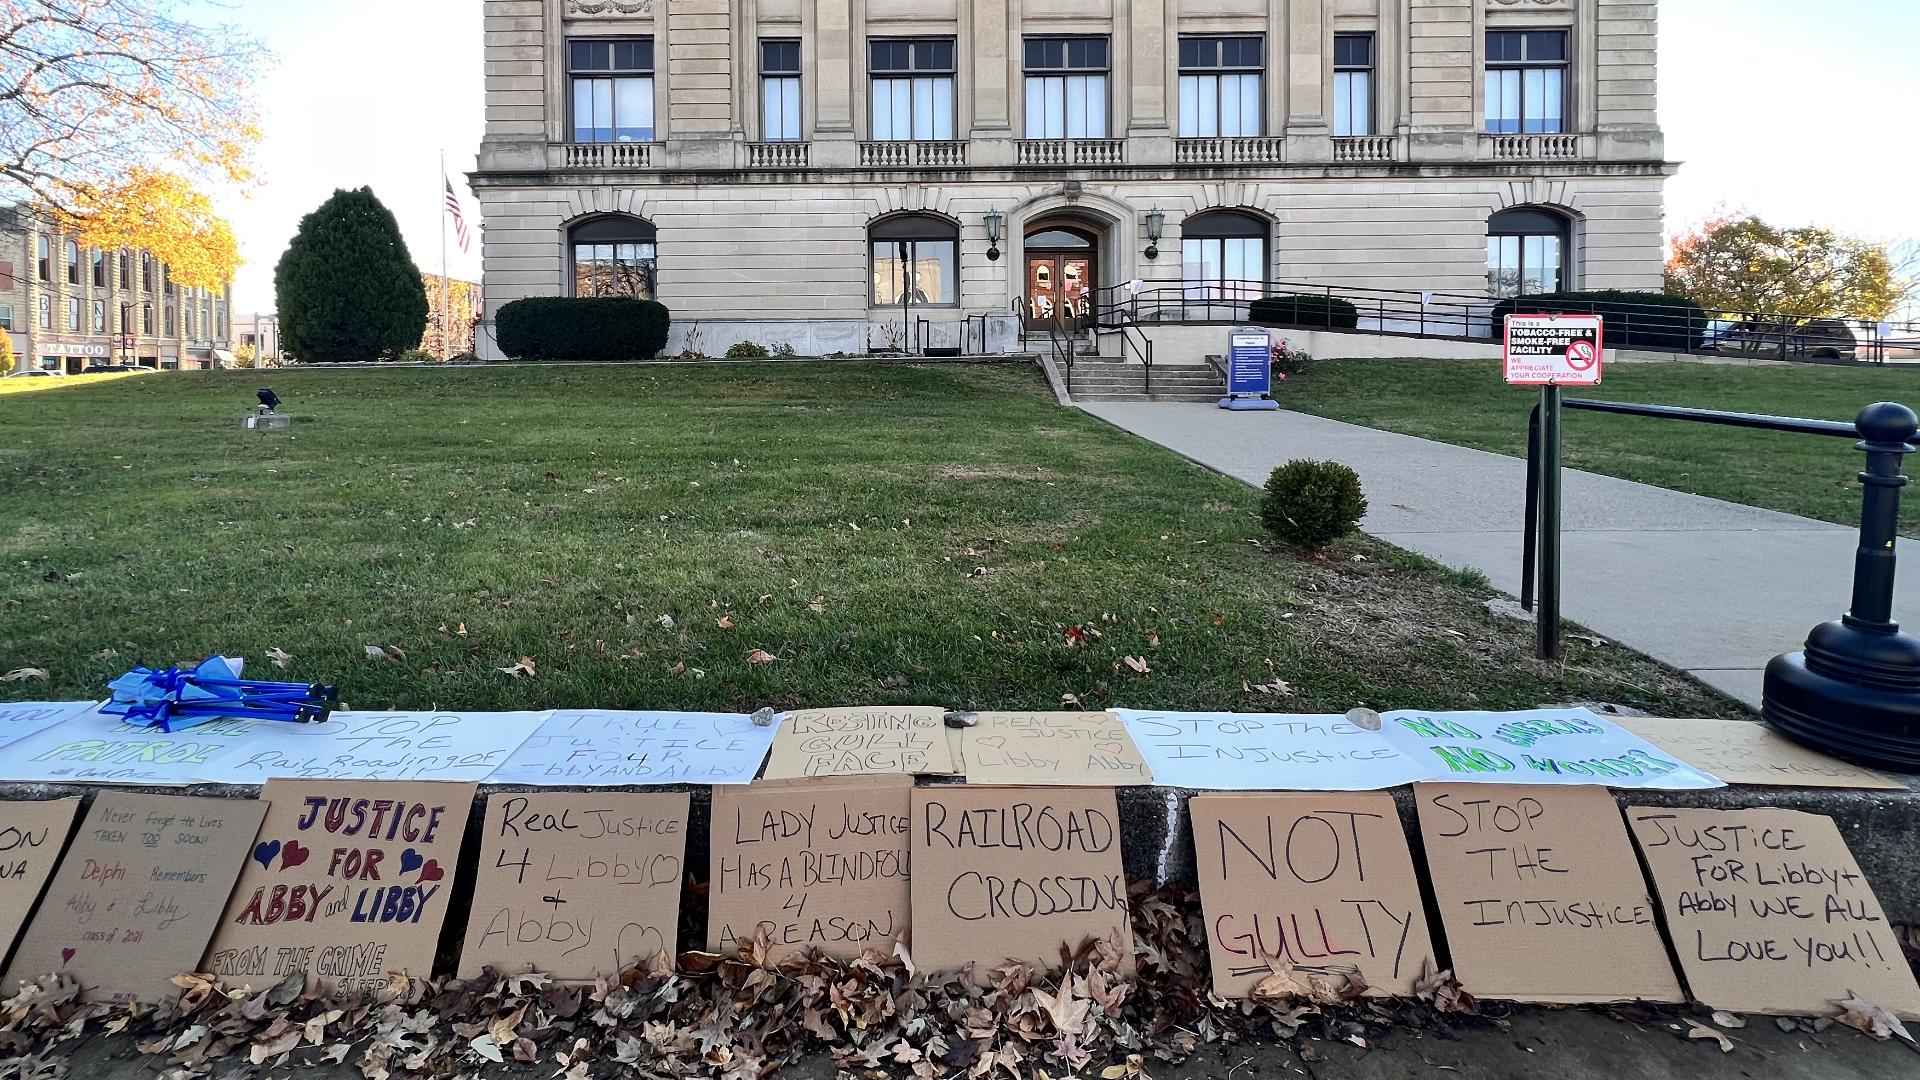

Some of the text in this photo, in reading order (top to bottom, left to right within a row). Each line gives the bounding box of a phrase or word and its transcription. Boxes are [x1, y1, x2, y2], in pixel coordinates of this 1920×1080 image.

[1510, 329, 1593, 337] TOBACCO-FREE &
[1510, 338, 1571, 346] SMOKE-FREE
[47, 344, 104, 355] TATTOO
[1510, 346, 1553, 354] FACILITY
[290, 714, 462, 735] STOP
[992, 716, 1072, 729] REAL
[1020, 728, 1125, 741] JUSTICE
[1136, 717, 1264, 736] STOP
[1394, 716, 1482, 741] NO
[28, 739, 224, 764] PATROL
[804, 750, 928, 776] FACE
[978, 752, 1059, 771] Libby
[1430, 745, 1516, 774] NO
[100, 808, 136, 824] Never
[146, 812, 176, 831] Forget
[297, 796, 446, 843] JUSTICE
[735, 802, 909, 848] LADY JUSTICE
[925, 802, 1113, 853] RAILROAD
[1433, 794, 1544, 836] STOP
[94, 830, 127, 842] TAKEN
[141, 833, 161, 844] TOO
[1218, 810, 1383, 884] NOT
[81, 859, 127, 888] Delphi
[327, 848, 384, 880] FOR
[495, 847, 649, 886] 4 Libby
[720, 854, 772, 894] HAS
[779, 856, 794, 889] A
[1465, 844, 1569, 880] THE
[1691, 855, 1748, 887] FOR
[133, 891, 190, 931] Libby
[234, 883, 440, 925] ABBY and LIBBY
[782, 892, 808, 918] 4
[1679, 891, 1881, 923] Abby WE ALL
[479, 907, 595, 957] Abby
[719, 923, 739, 950] A
[1697, 929, 1788, 961] LOVE
[208, 941, 388, 977] FROM THE CRIME
